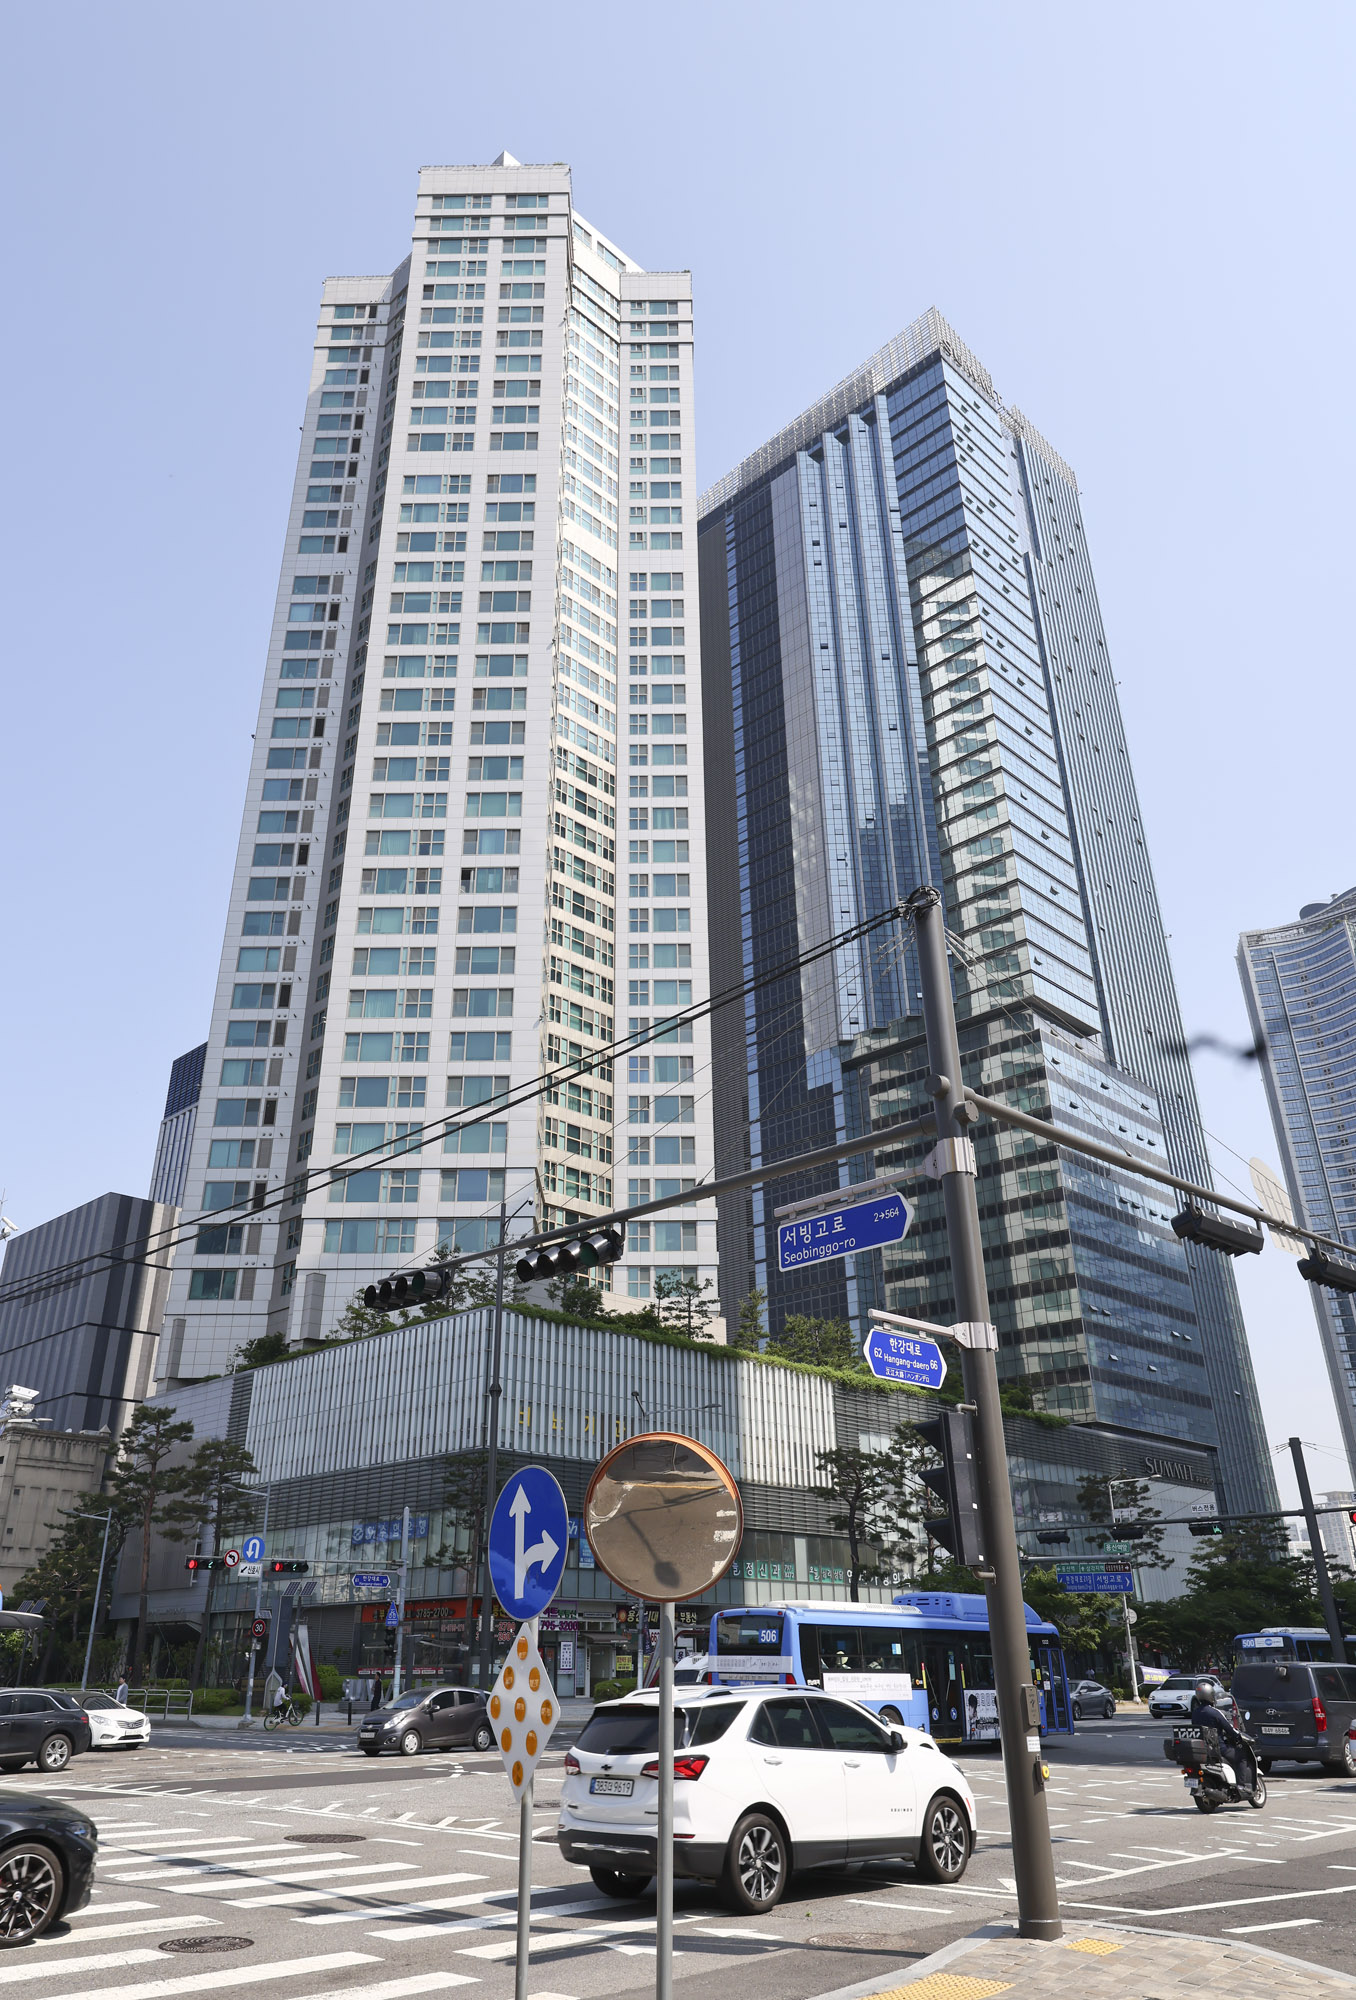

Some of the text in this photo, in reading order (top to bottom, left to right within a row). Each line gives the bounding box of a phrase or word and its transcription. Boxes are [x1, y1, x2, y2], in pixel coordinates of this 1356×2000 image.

[783, 1215, 847, 1247] 서빙고로
[783, 1237, 857, 1265] Seobinggo-ro
[889, 1337, 923, 1357] 한강대로
[873, 1347, 939, 1371] 62 Hangang-daero 66
[1145, 1456, 1194, 1481] SUMMIT
[1191, 1503, 1216, 1512] 버스전용
[1096, 1575, 1123, 1584] 서빙고로
[254, 1623, 264, 1633] 30
[760, 1629, 777, 1642] 506
[1242, 1639, 1255, 1648] 500
